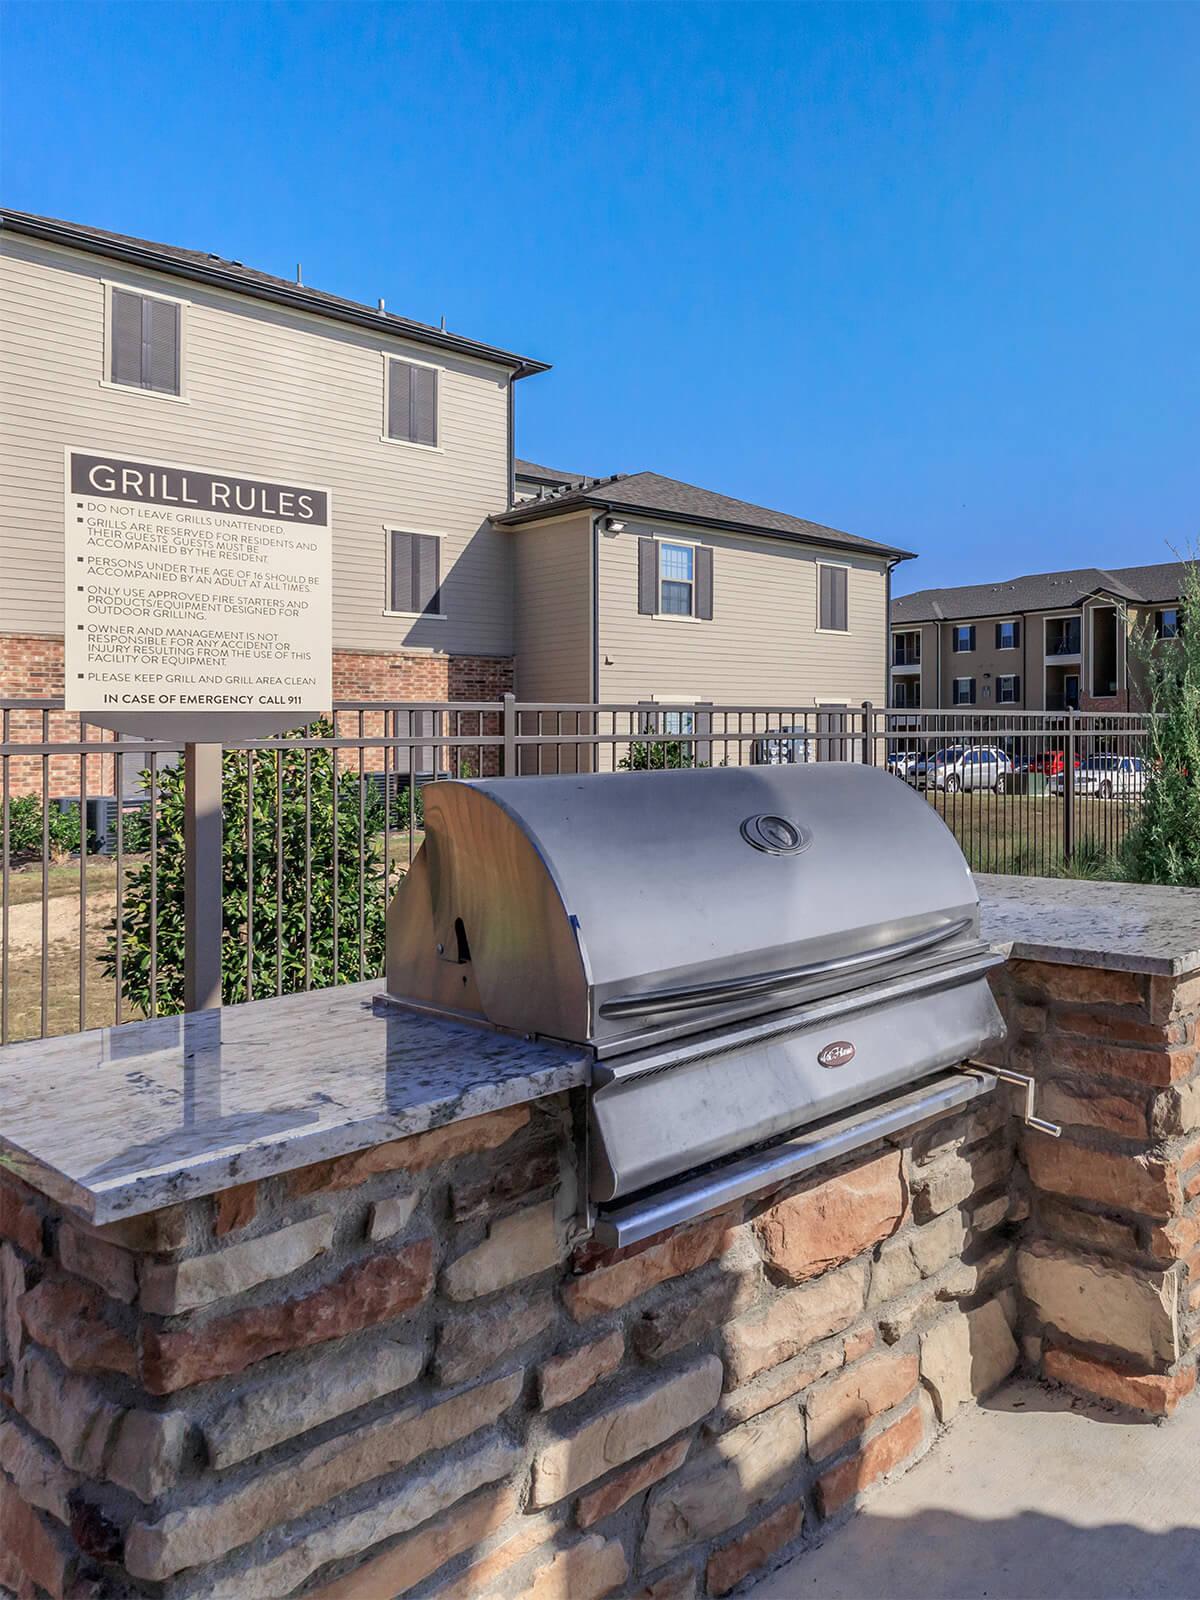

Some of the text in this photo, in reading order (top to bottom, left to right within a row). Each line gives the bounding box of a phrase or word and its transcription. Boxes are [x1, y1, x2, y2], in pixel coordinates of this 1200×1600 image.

[89, 465, 313, 519] GRILL RULES
[87, 503, 106, 513] DO
[111, 506, 134, 516] NOT
[138, 509, 173, 521] LEAVE
[176, 514, 212, 526] GRILLS
[87, 518, 317, 552] GRILLS ARE RESERVED FOR RESIDENTS AND
[88, 527, 122, 539] THEIR
[173, 537, 214, 549] GUESTS
[216, 542, 244, 552] MUST
[247, 546, 258, 554] BE
[88, 537, 177, 554] ACCOMPANIED
[180, 547, 193, 556] BY
[196, 549, 216, 558] THE
[88, 556, 143, 569] PERSONS
[147, 562, 186, 573] UNDER
[189, 566, 209, 575] THE
[213, 568, 234, 578] AGE
[237, 571, 251, 579] OF
[254, 572, 262, 580] 16
[266, 574, 306, 584] SHOULD
[88, 566, 177, 581] ACCOMPANIED
[181, 575, 192, 583] BY
[196, 576, 212, 584] AN
[214, 578, 247, 587] ADULT
[250, 581, 261, 589] AT
[264, 582, 280, 590] ALL
[88, 585, 308, 609] ONLY USE APPROVED FIRE STARTERS AND
[88, 595, 299, 617] PRODUCTS/EQUIPMENT DESIGNED FOR
[88, 605, 206, 620] OUTDOOR GRILLING.
[88, 624, 134, 634] OWNER
[137, 627, 163, 636] AND
[166, 629, 244, 640] MANAGEMENT
[258, 634, 278, 642] NOT
[88, 634, 167, 645] RESPONSIBLE
[171, 638, 193, 646] FOR
[196, 640, 220, 648] ANY
[221, 641, 273, 650] ACCIDENT
[88, 644, 130, 653] INJURY
[134, 646, 194, 656] RESULTING
[198, 649, 229, 657] FROM
[232, 650, 250, 658] THE
[254, 651, 272, 659] USE
[88, 654, 138, 663] FACILITY
[141, 656, 158, 664] OR
[88, 673, 316, 686] PLEASE KEEP GRILL AND GRILL AREA CLEAN
[104, 694, 118, 703] IN
[121, 695, 155, 703] CASE
[159, 695, 176, 703] OF
[180, 696, 254, 704] EMERGENCY
[288, 697, 302, 705] 911
